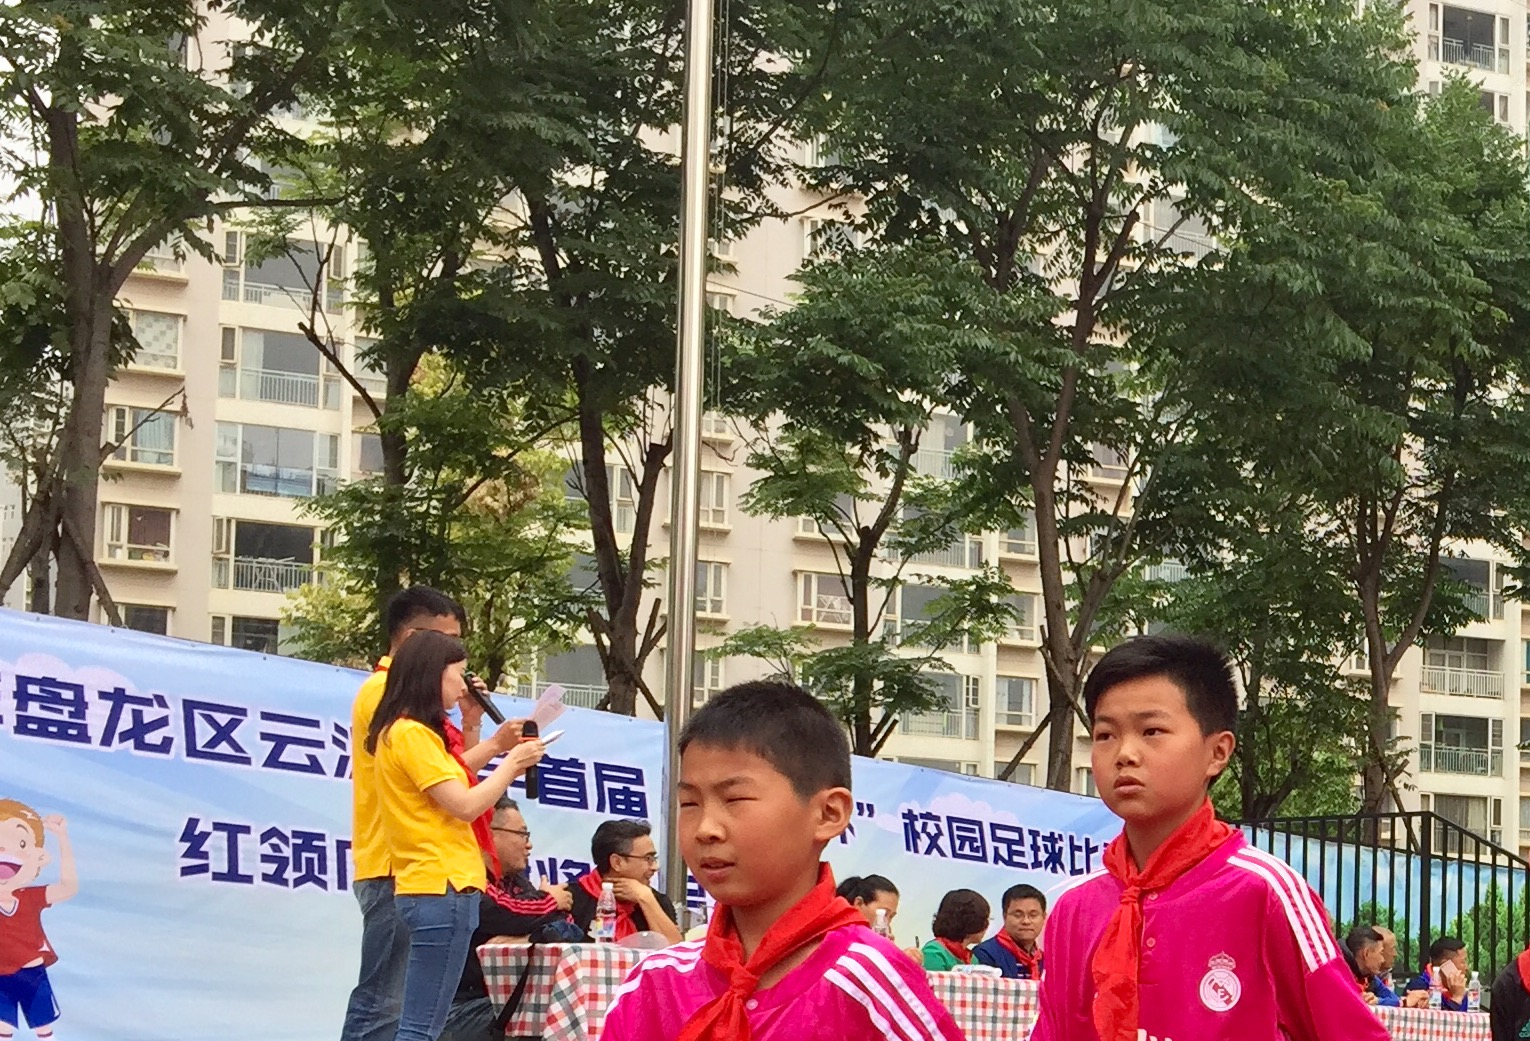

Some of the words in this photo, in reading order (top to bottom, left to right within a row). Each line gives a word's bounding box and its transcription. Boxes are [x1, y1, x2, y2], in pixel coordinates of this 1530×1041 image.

[901, 808, 1110, 877] 校园足球比
